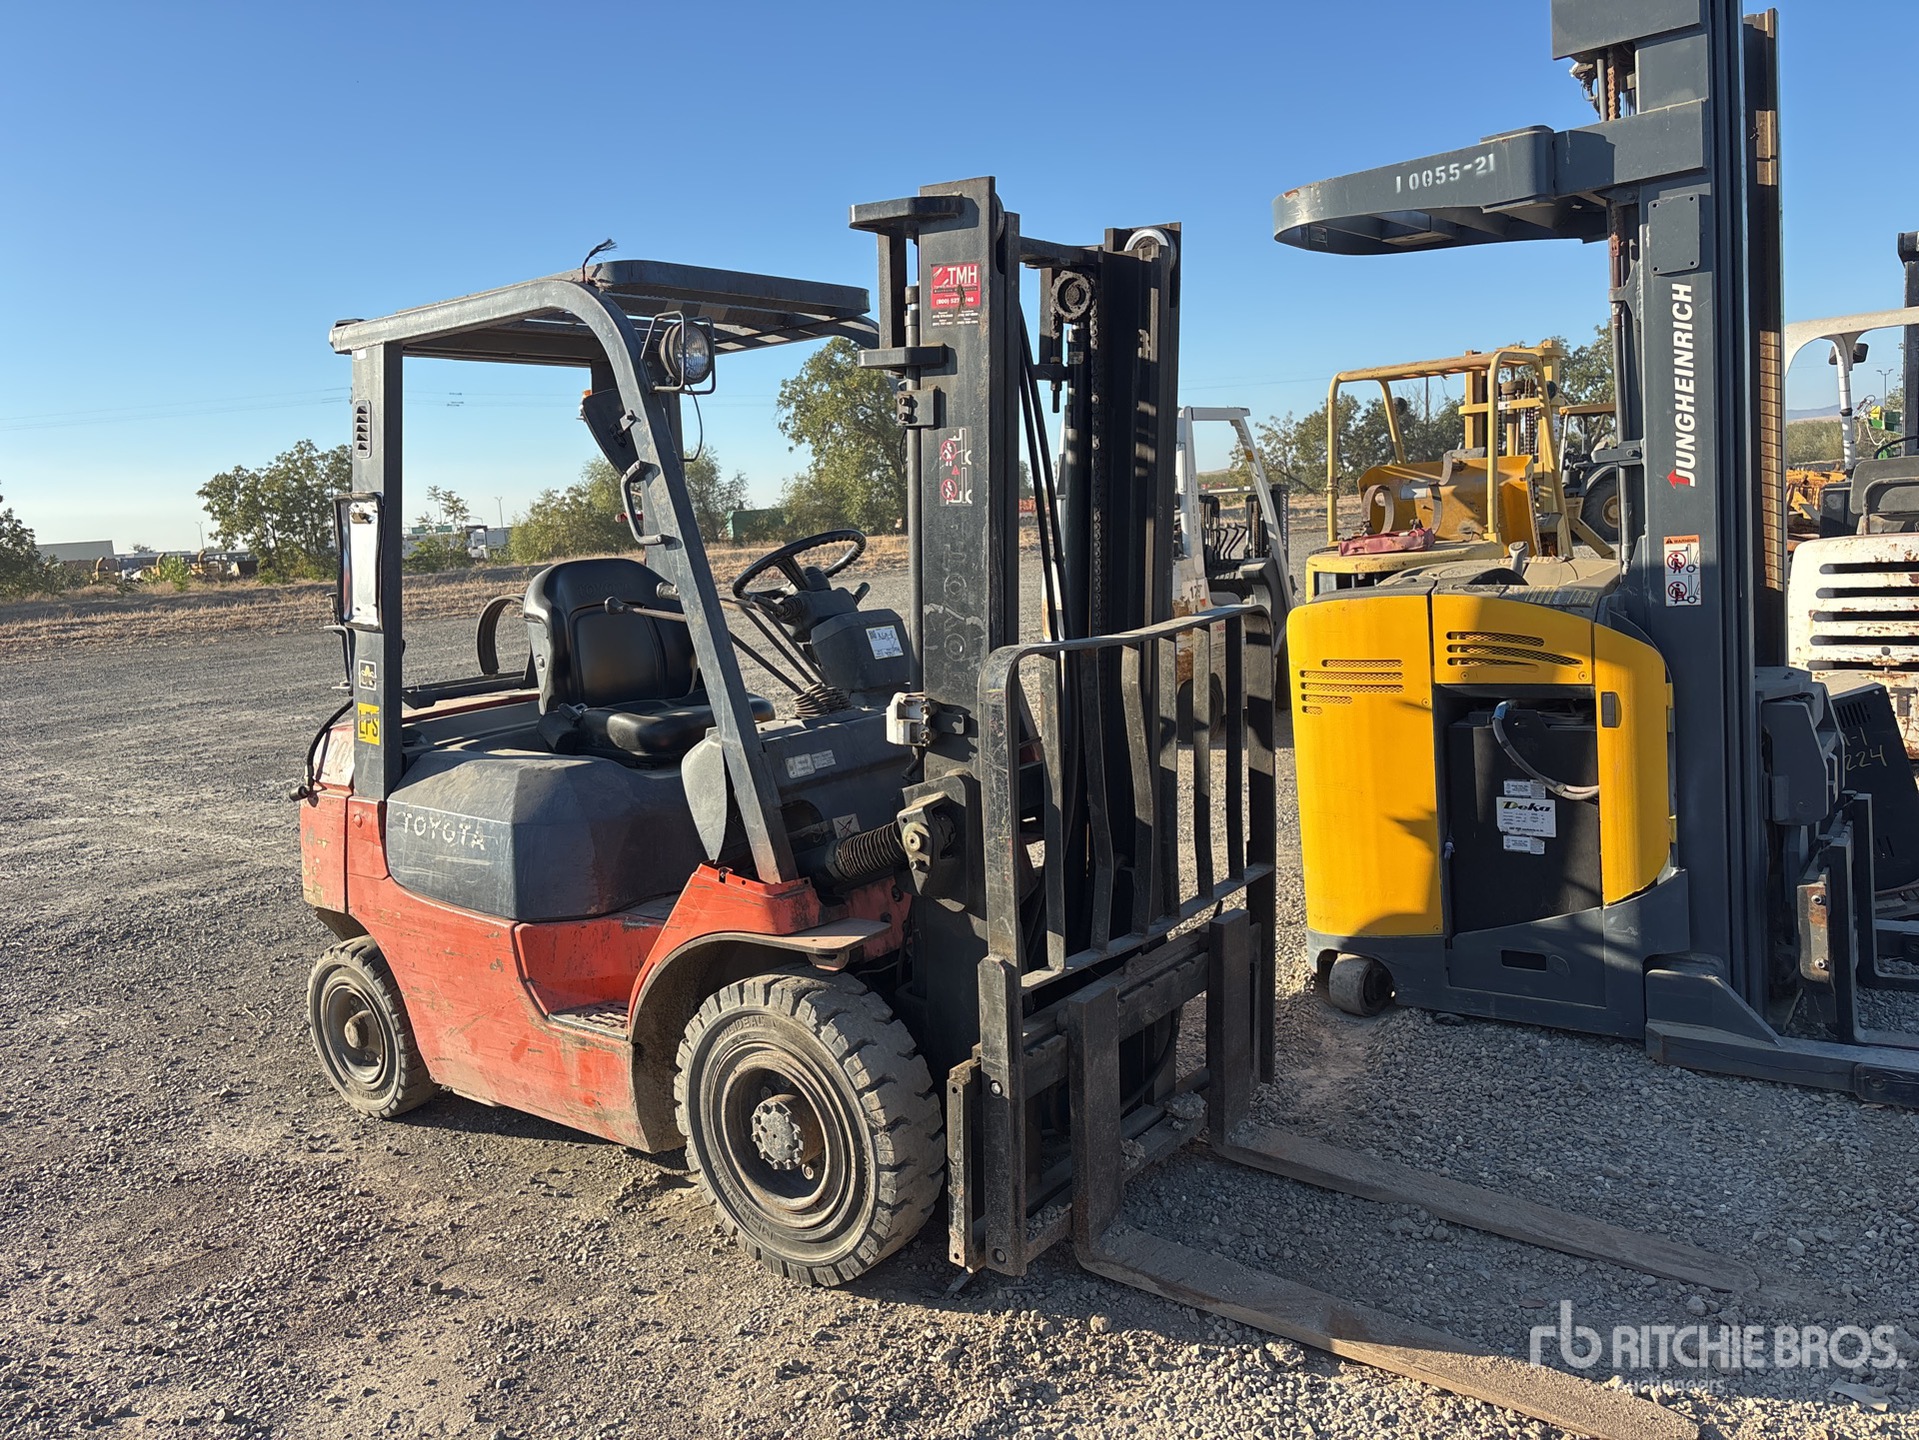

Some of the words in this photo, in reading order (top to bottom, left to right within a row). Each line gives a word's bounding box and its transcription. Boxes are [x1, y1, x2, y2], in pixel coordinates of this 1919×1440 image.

[1396, 153, 1494, 193] 10055-21
[947, 265, 978, 285] TMH
[1671, 283, 1696, 487] JUNGHEINRICH
[359, 710, 379, 738] LPS
[1502, 801, 1551, 812] Deka
[396, 811, 485, 850] TOYOTA
